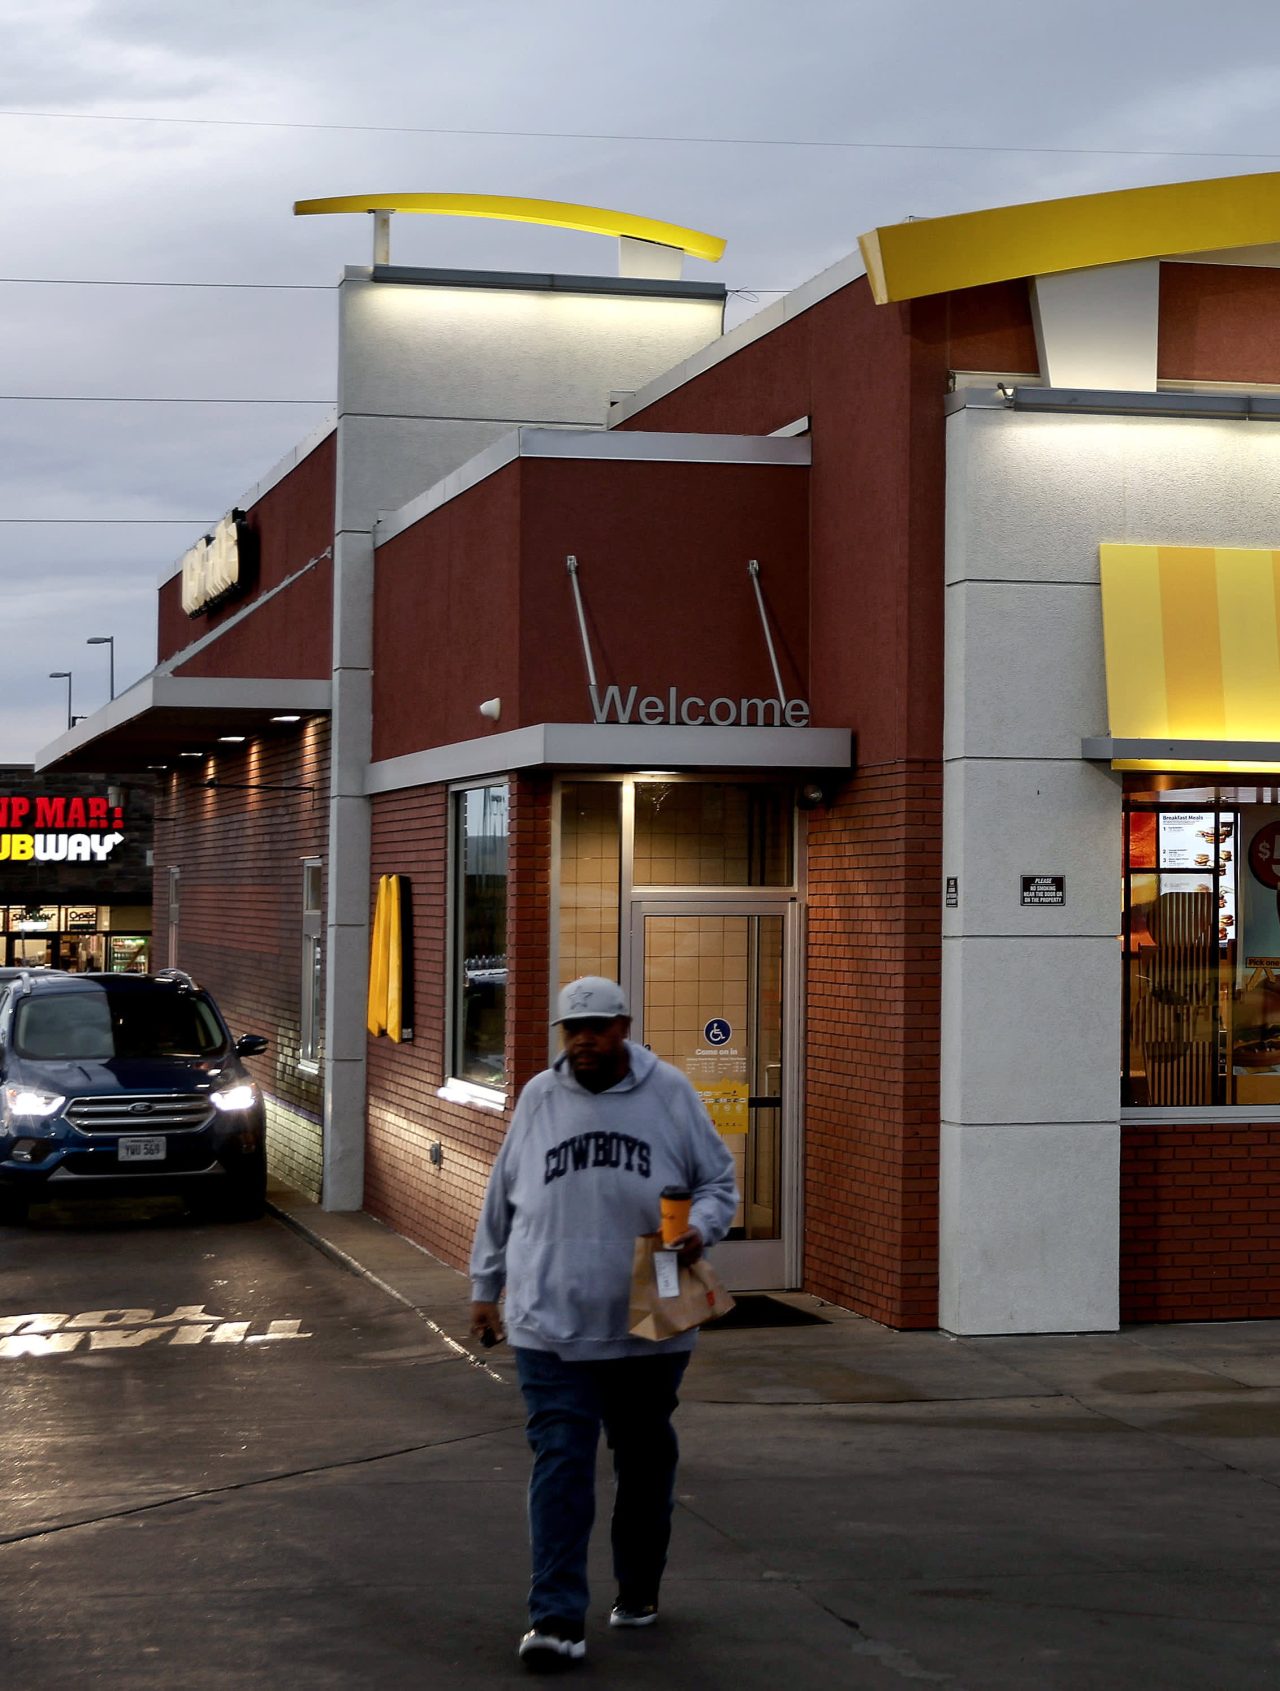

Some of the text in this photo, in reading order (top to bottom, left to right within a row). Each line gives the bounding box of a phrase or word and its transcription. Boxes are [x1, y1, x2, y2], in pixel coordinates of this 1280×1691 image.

[588, 684, 811, 728] Welcome
[0, 796, 30, 828] P
[544, 1131, 651, 1185] COWBOYS
